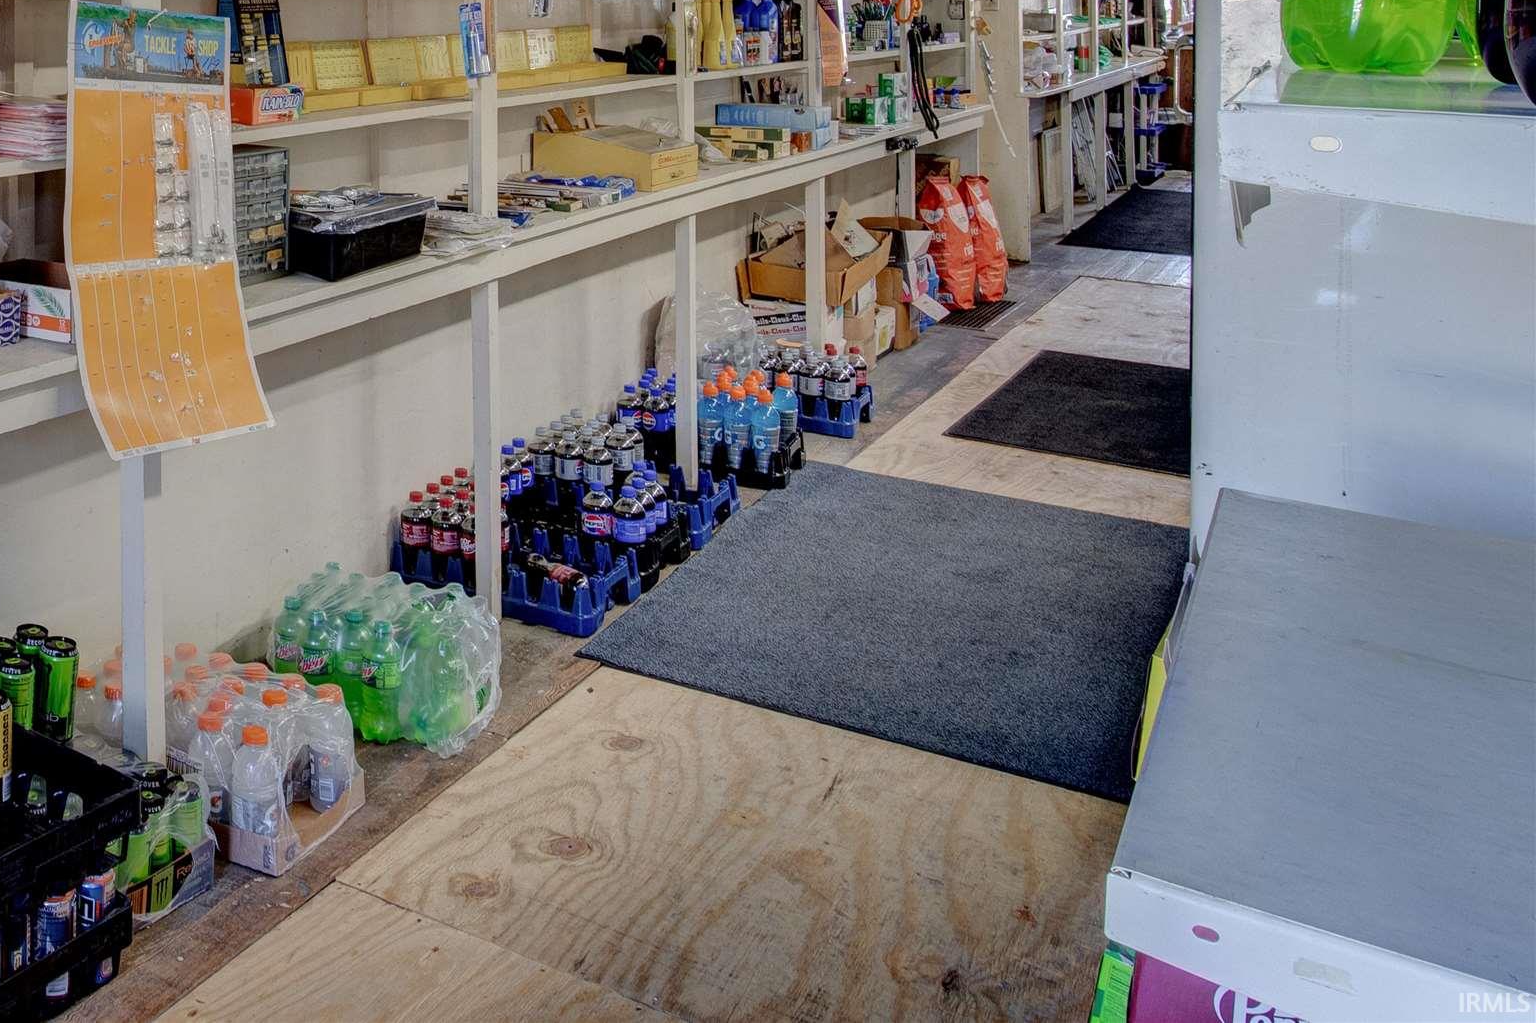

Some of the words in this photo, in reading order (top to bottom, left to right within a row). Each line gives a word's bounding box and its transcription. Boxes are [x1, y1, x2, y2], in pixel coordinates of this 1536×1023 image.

[143, 35, 177, 56] TACKLE
[198, 41, 219, 57] SHOP
[584, 518, 606, 529] PEPSI
